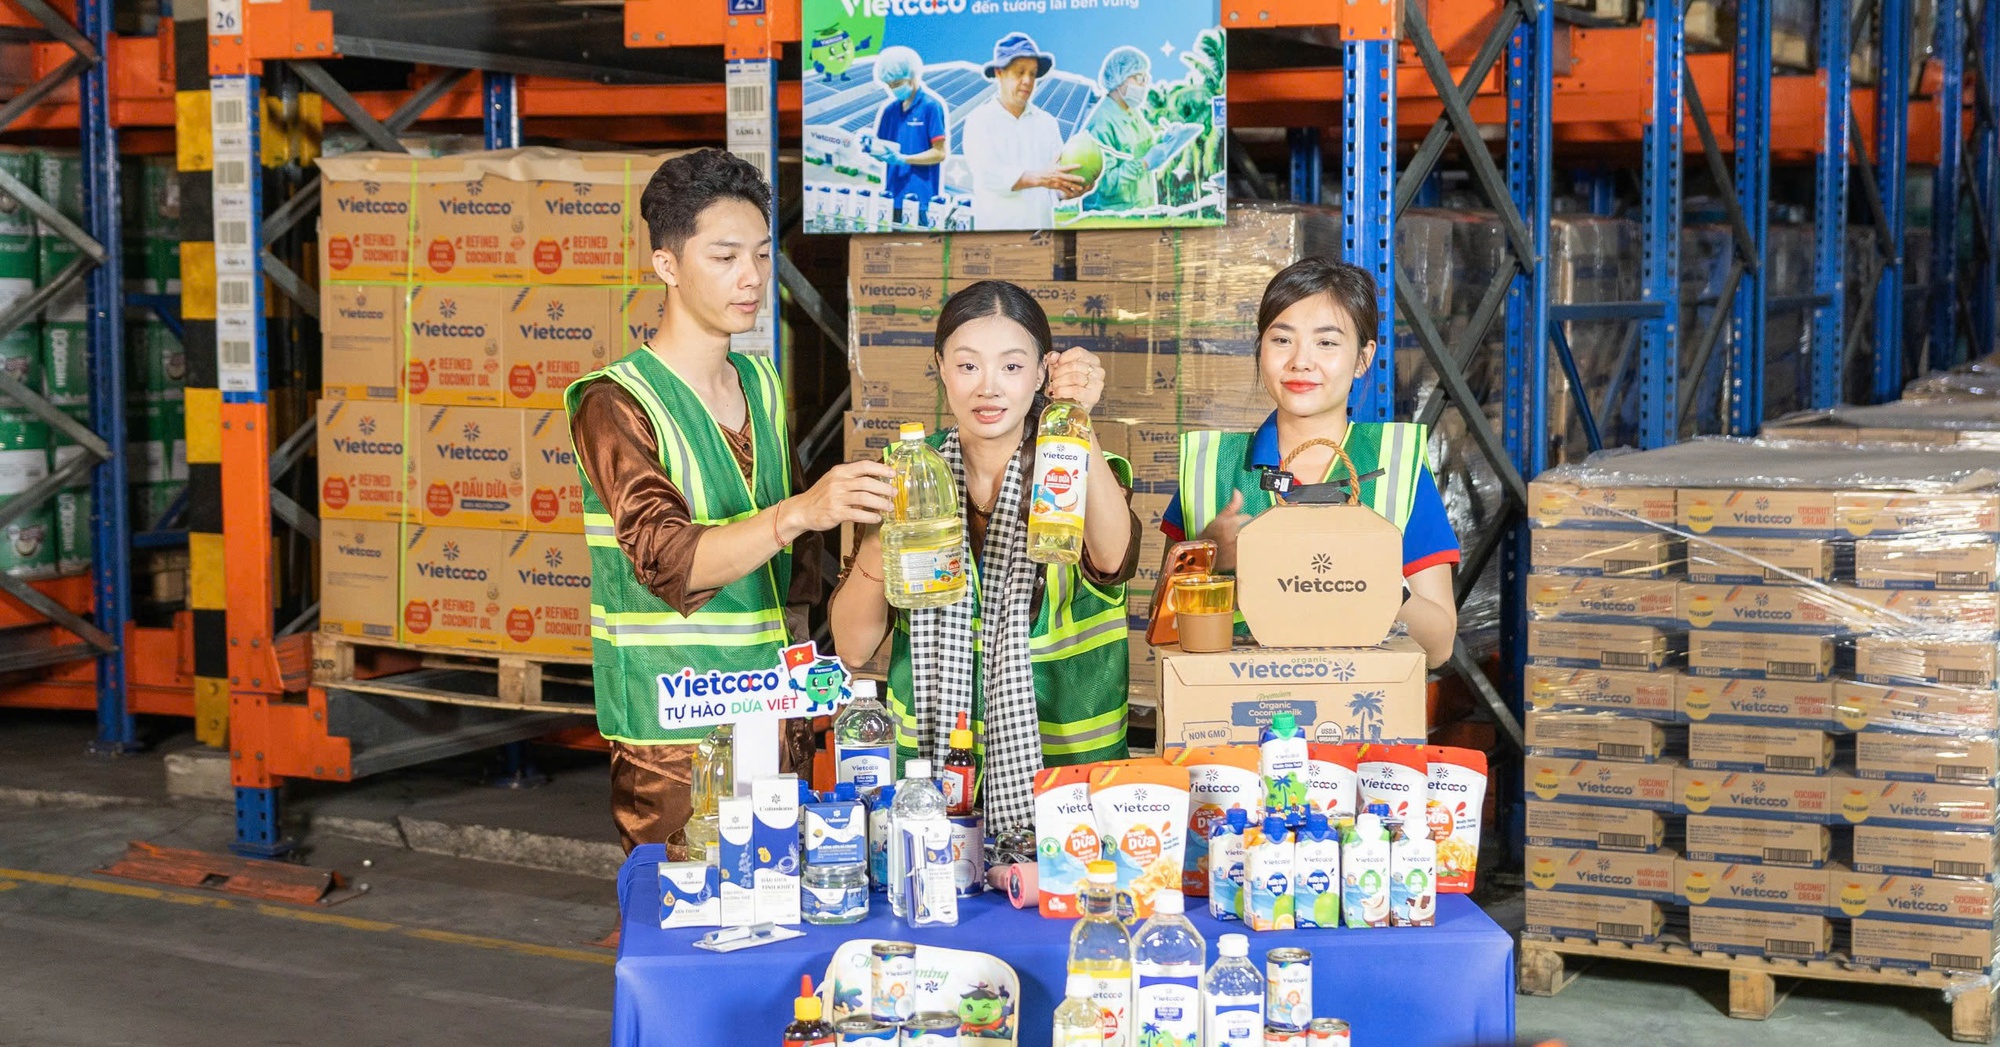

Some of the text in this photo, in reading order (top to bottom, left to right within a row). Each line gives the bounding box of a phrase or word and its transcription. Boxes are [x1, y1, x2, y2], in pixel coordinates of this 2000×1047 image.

[842, 0, 966, 17] Vietcoco
[216, 12, 235, 28] 26
[338, 196, 408, 214] Vietcoco
[439, 196, 512, 215] Vietcoco
[545, 197, 621, 215] Vietcoco
[573, 236, 608, 249] REFINED
[573, 252, 611, 265] COCONUT
[860, 284, 917, 297] Vietcoco
[339, 308, 384, 319] Vietcoco
[412, 319, 486, 337] Vietcoco
[520, 321, 593, 340] Vietcoco
[439, 357, 473, 371] REFINED
[547, 361, 580, 374] REFINED
[439, 373, 476, 386] COCONUT
[852, 417, 902, 431] Vietco
[334, 436, 404, 454] Vietcoco
[437, 443, 508, 461] Vietcoco
[542, 447, 577, 465] Viet
[1043, 452, 1078, 460] Vietcoco
[462, 476, 508, 499] DẦU DỪA
[1582, 505, 1638, 517] Vietcoco
[1733, 511, 1791, 524] Vietcoco
[1797, 506, 1830, 515] COCONUT
[1802, 516, 1826, 525] CREAM
[338, 544, 382, 558] Vietcoco
[417, 561, 488, 581] Vietcoco
[518, 568, 591, 588] Vietcoco
[1277, 575, 1367, 593] Vietcoco
[443, 599, 475, 612] REFINED
[1580, 600, 1635, 612] Vietcoco
[1733, 605, 1791, 619] Vietcoco
[546, 606, 579, 620] REFINED
[442, 614, 477, 628] COCONUT
[545, 622, 582, 636] COCONUT
[1291, 656, 1327, 665] organic
[1229, 658, 1329, 679] Vietcoco
[661, 670, 779, 698] Vietcoco
[1256, 690, 1291, 702] Premium
[665, 695, 798, 723] TỰ HÀO DỪA VIỆT
[1259, 701, 1291, 710] Organic
[1730, 699, 1788, 713] Vietcoco
[1188, 728, 1226, 741] NON GMO
[1361, 778, 1410, 792] Vietcoco
[1428, 780, 1467, 792] etcoco
[1577, 780, 1632, 795] Vietcoco
[1638, 778, 1669, 787] COCONUT
[1730, 793, 1788, 807] Vietcoco
[1794, 790, 1826, 800] COCONUT
[1057, 803, 1093, 814] Vietco
[1114, 803, 1171, 813] Vietcoco
[1798, 800, 1822, 810] CREAM
[1889, 803, 1950, 818] Vietcoco
[1072, 834, 1096, 851] Dừa
[1128, 836, 1157, 850] Dừa
[1576, 870, 1632, 885] Vietcoco
[1730, 885, 1788, 899] Vietcoco
[1794, 882, 1826, 891] COCONUT
[1887, 897, 1948, 912] Vietcoco
[1954, 895, 1988, 906] COCONUT
[1958, 905, 1983, 915] CREAM
